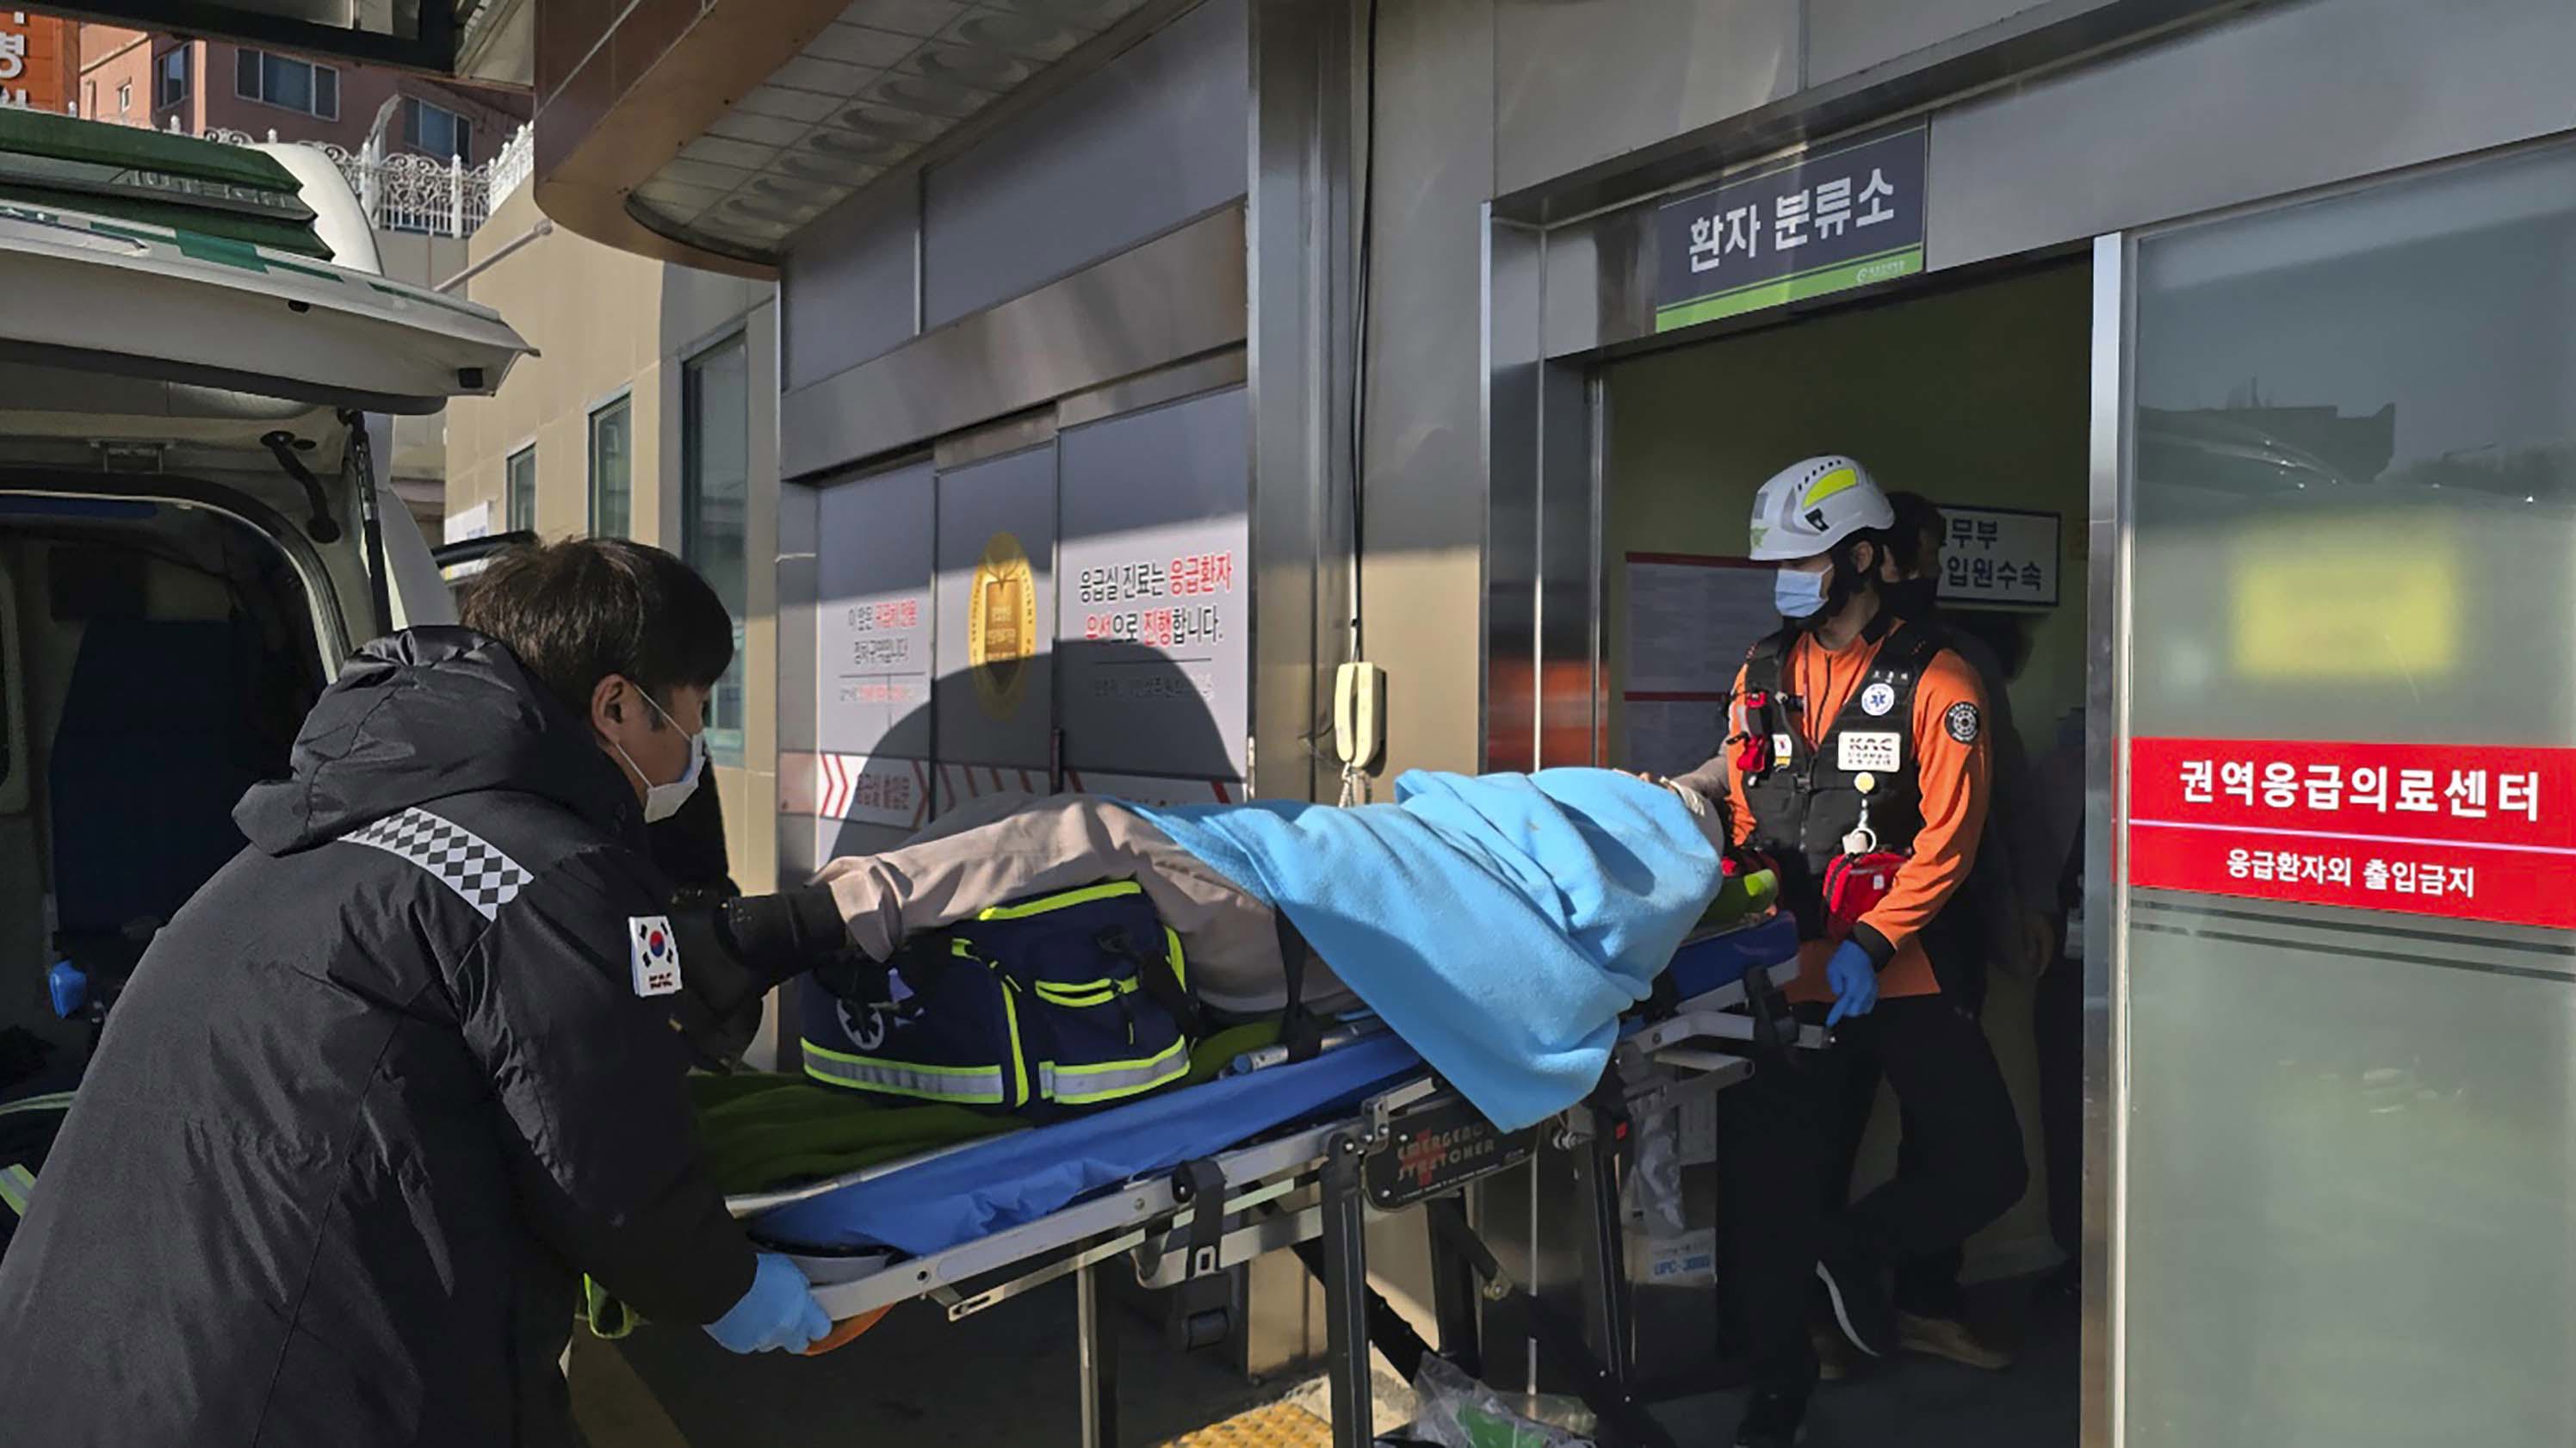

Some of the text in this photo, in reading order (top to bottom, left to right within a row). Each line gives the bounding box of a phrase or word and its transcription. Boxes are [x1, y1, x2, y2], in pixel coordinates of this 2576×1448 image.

[1689, 167, 1895, 273] 환자 분류소
[1941, 517, 1998, 550] 무부
[1080, 552, 1232, 603] 응급실 진료는 응급환자
[1947, 556, 2042, 591] 입원수속
[1143, 605, 1223, 646] 진행합니다.
[2179, 758, 2540, 821] 권역응급의료센터
[2226, 848, 2476, 898] 응급환자외 출입금지
